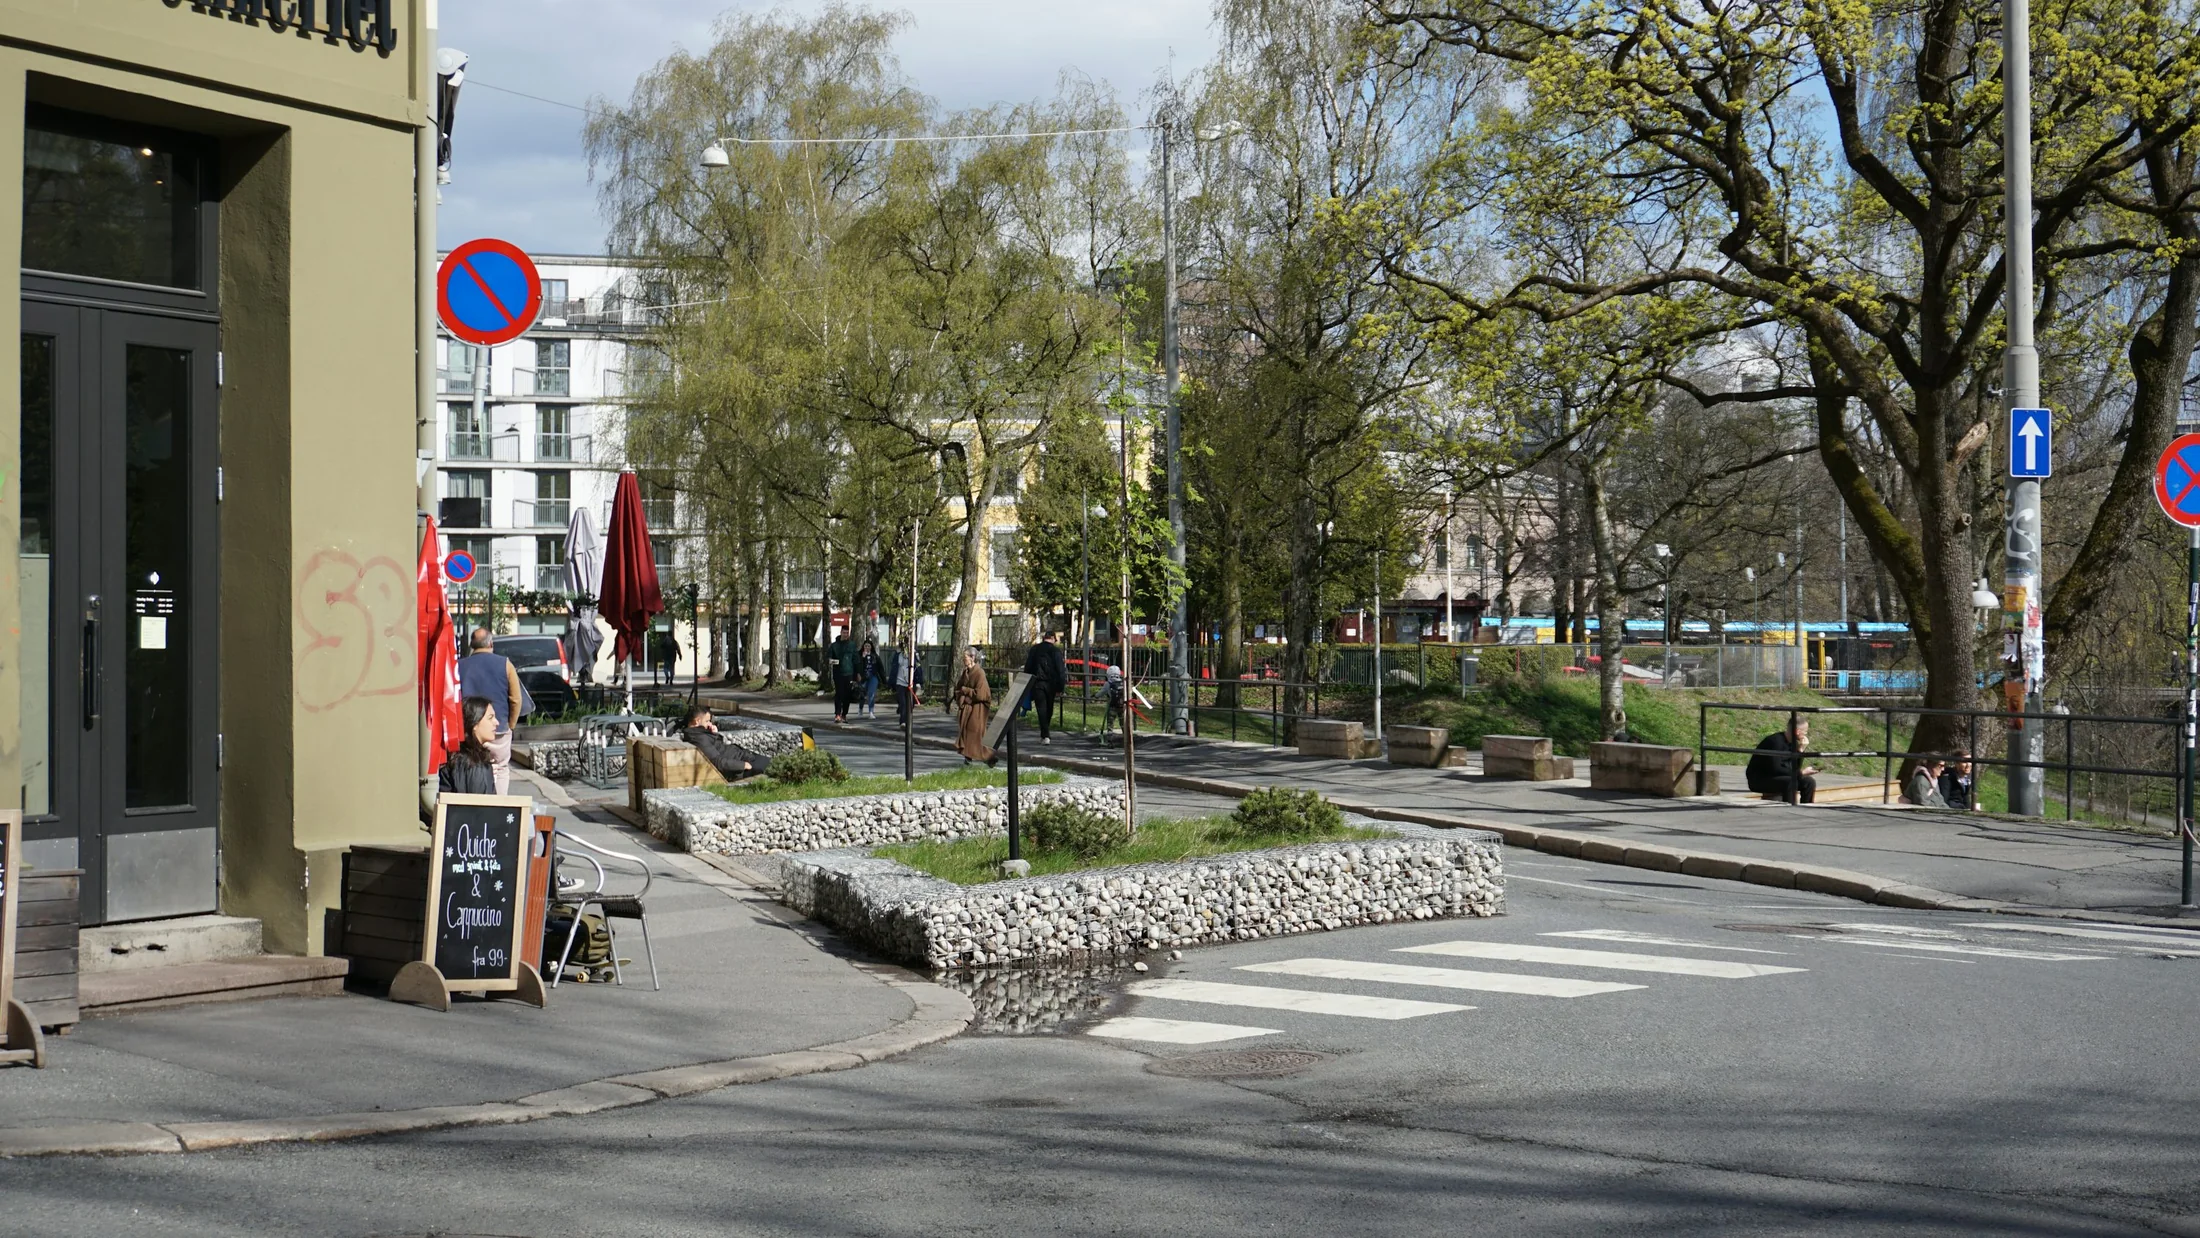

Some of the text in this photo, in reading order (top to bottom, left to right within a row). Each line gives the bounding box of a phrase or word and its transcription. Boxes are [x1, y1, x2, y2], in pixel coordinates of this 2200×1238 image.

[457, 822, 497, 861] Quiche
[452, 861, 465, 874] med
[471, 873, 481, 897] &
[446, 891, 502, 939] Cappuccino
[472, 945, 485, 978] fra
